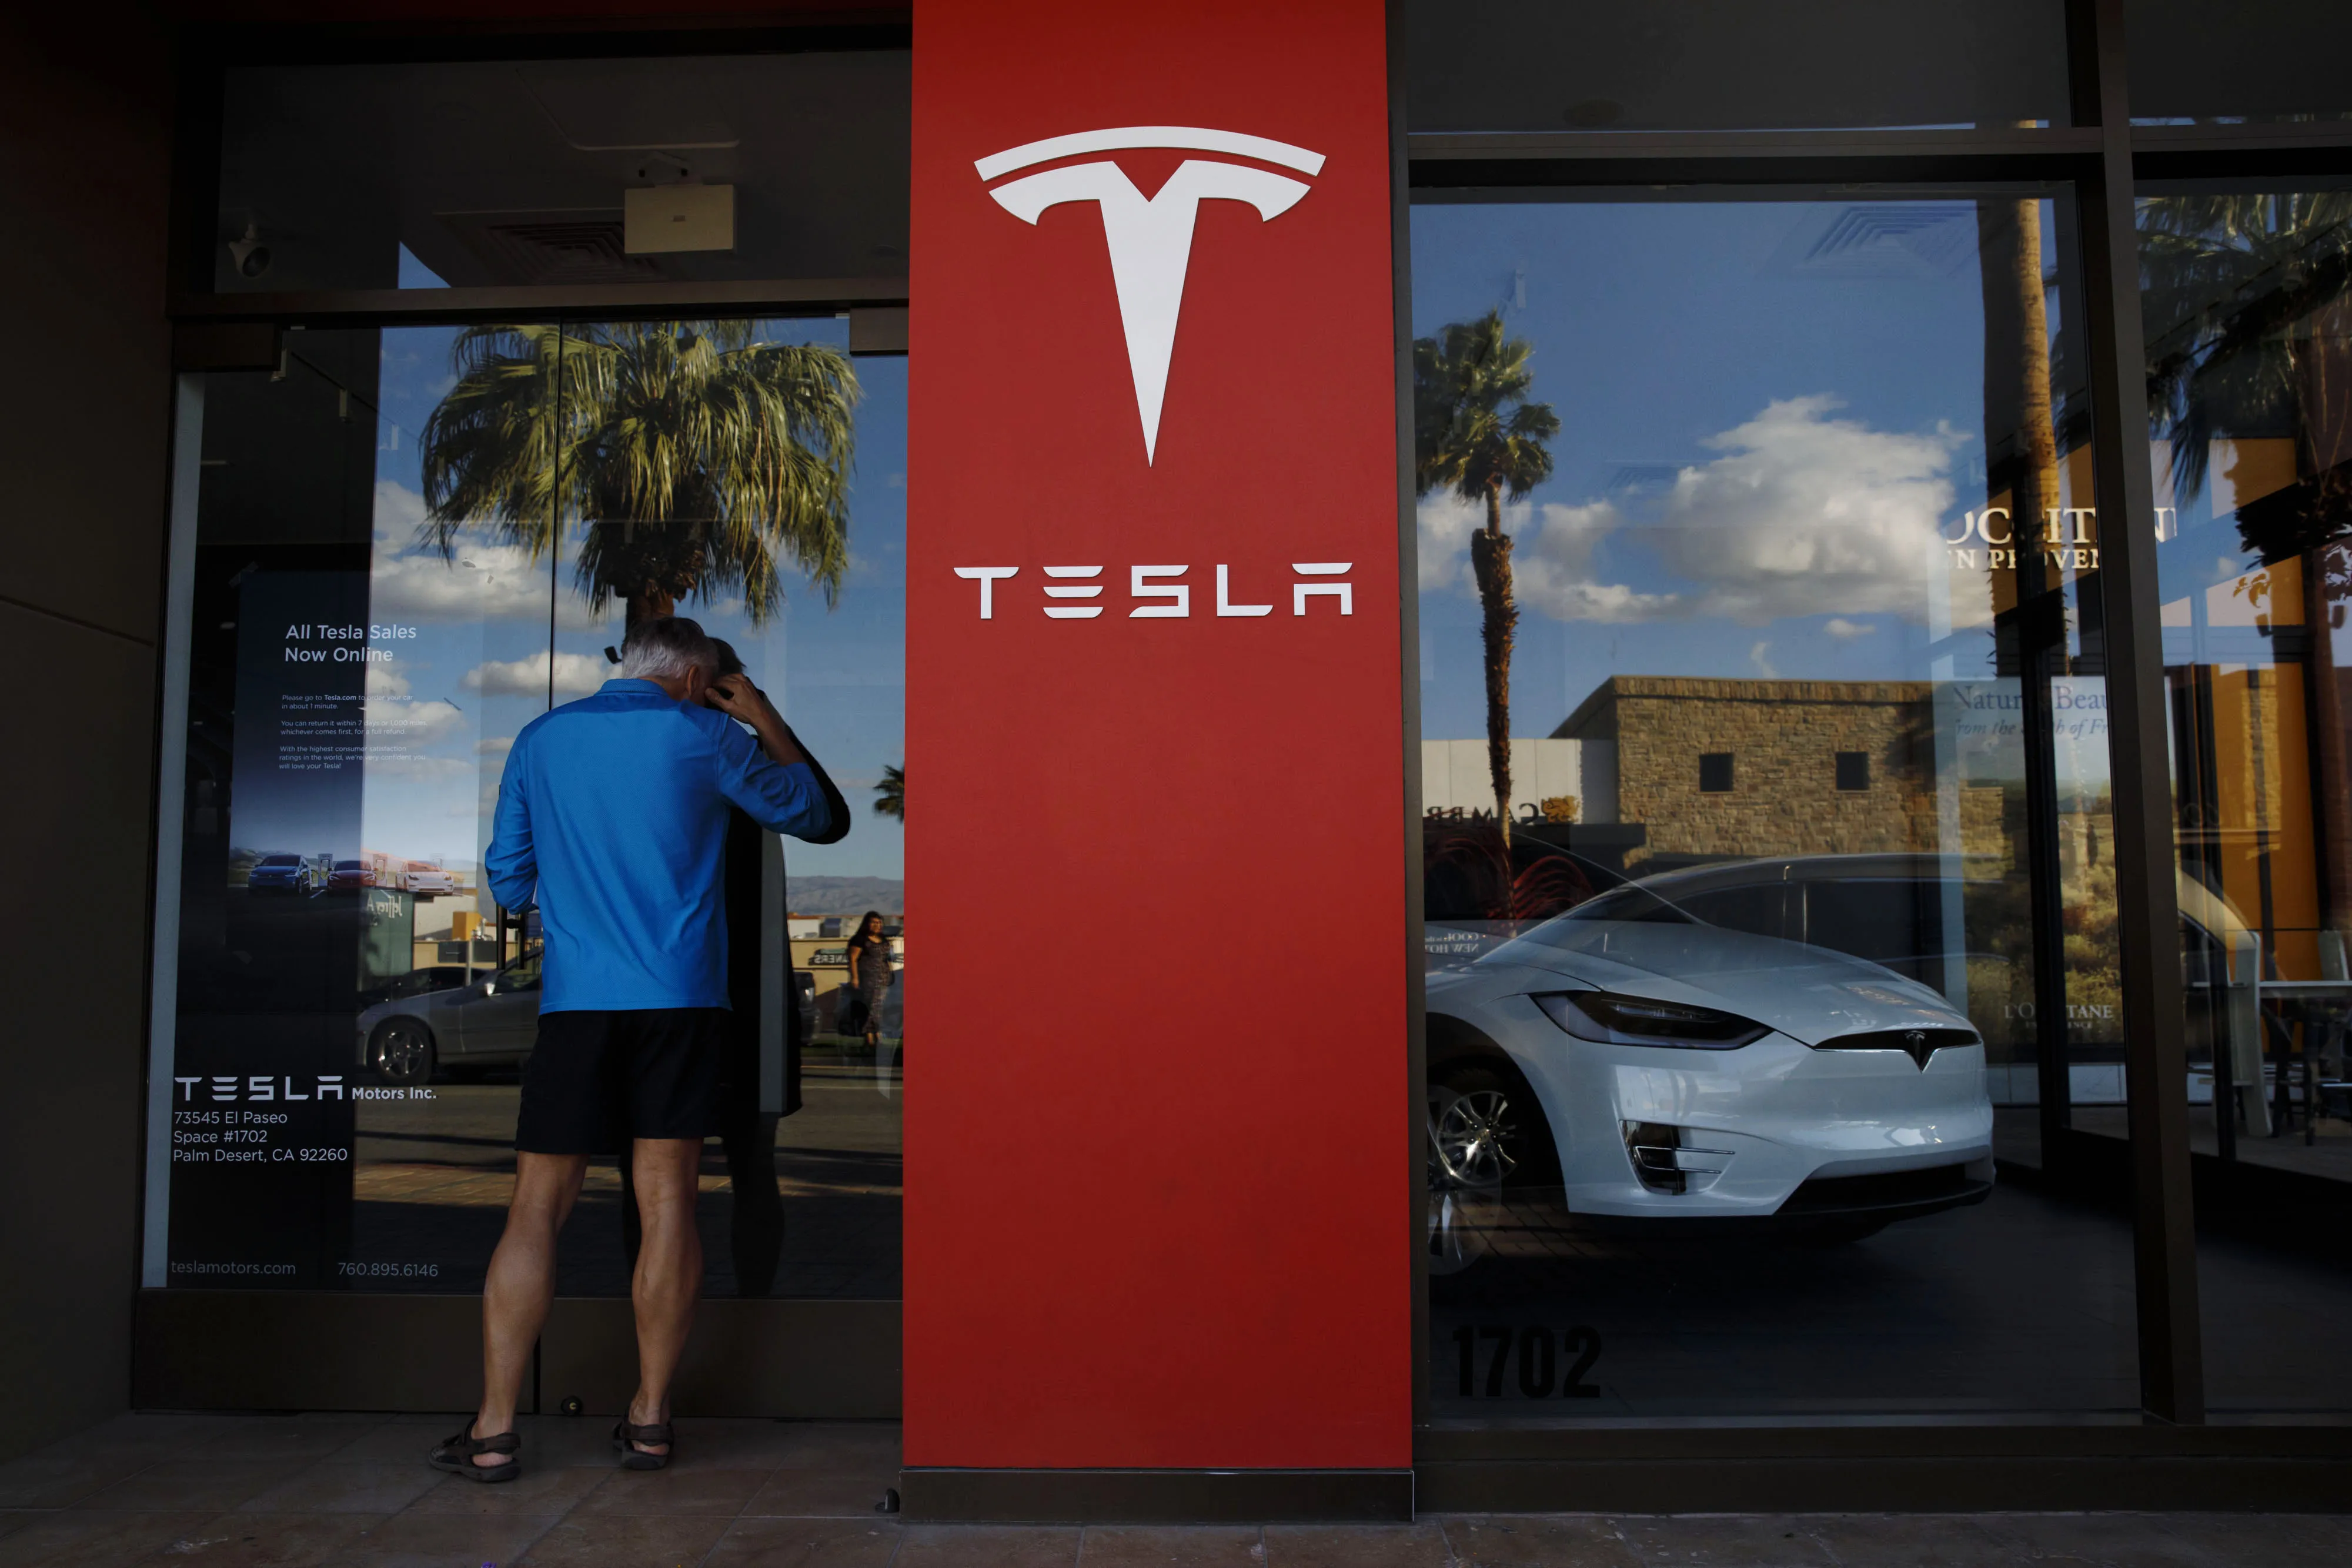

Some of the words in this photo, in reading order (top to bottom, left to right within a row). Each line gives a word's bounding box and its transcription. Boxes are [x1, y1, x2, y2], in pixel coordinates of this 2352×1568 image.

[954, 563, 1353, 620] TESLA
[285, 624, 310, 639] All
[318, 624, 363, 639] Tesla
[370, 624, 416, 639] Sales
[285, 647, 327, 662] Now
[333, 647, 393, 662] Online
[175, 1075, 343, 1101] TESLA
[352, 1087, 405, 1100] Motors
[410, 1087, 436, 1100] Inc.
[174, 1111, 219, 1124] 73545
[225, 1111, 238, 1124] El
[243, 1111, 288, 1124] Paseo
[174, 1131, 218, 1145] Space
[223, 1130, 268, 1143] #1702
[174, 1149, 209, 1162] Palm
[215, 1149, 267, 1164] Desert,
[272, 1149, 294, 1162] CA
[299, 1148, 348, 1161] 92260
[171, 1261, 296, 1275] teslamotors.com
[338, 1262, 439, 1277] 760.895.6146
[1452, 1325, 1602, 1399] 1702
